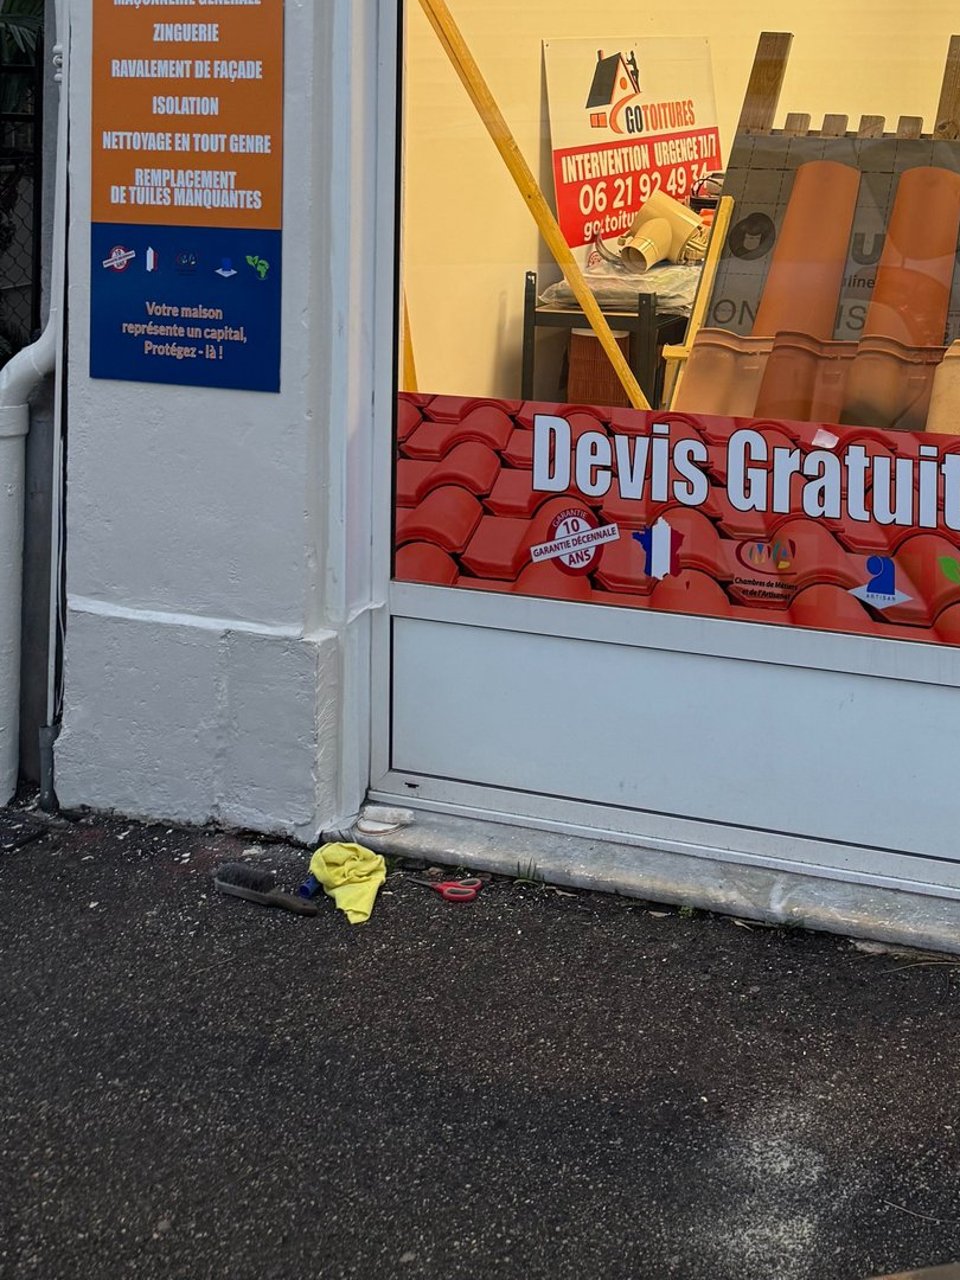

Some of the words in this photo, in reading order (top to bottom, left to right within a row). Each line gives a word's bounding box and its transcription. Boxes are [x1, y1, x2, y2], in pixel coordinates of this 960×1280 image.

[153, 24, 219, 42] ZINGUERIE
[111, 59, 192, 78] RAVALEMENT
[195, 60, 211, 78] DE
[213, 60, 263, 82] FAÇADE
[152, 96, 219, 115] ISOLATION
[103, 131, 172, 151] NETTOYAGE
[174, 133, 190, 152] EN
[193, 133, 226, 152] TOUT
[229, 134, 271, 153] GENRE
[561, 144, 650, 184] INTERVENTION
[654, 135, 699, 168] URGENCE
[135, 168, 236, 189] REMPLACEMENT
[111, 186, 127, 204] DE
[129, 186, 171, 206] TUILES
[174, 188, 262, 209] MANQUANTES
[579, 181, 607, 216] 06
[612, 176, 632, 209] 21
[666, 167, 687, 196] 49
[146, 301, 179, 317] Votre
[181, 305, 223, 320] maison
[122, 321, 185, 337] représente
[187, 328, 202, 339] un
[204, 326, 247, 343] capital,
[144, 340, 196, 360] Protégez
[531, 413, 709, 507] Devis
[552, 509, 588, 527] GARANTIE
[562, 519, 580, 534] 10
[533, 540, 571, 558] GARANTIE
[571, 526, 617, 547] DÉCENNALE
[568, 549, 591, 566] ANS
[735, 577, 763, 587] Chambres
[765, 580, 774, 588] de
[775, 581, 798, 591] Métiers
